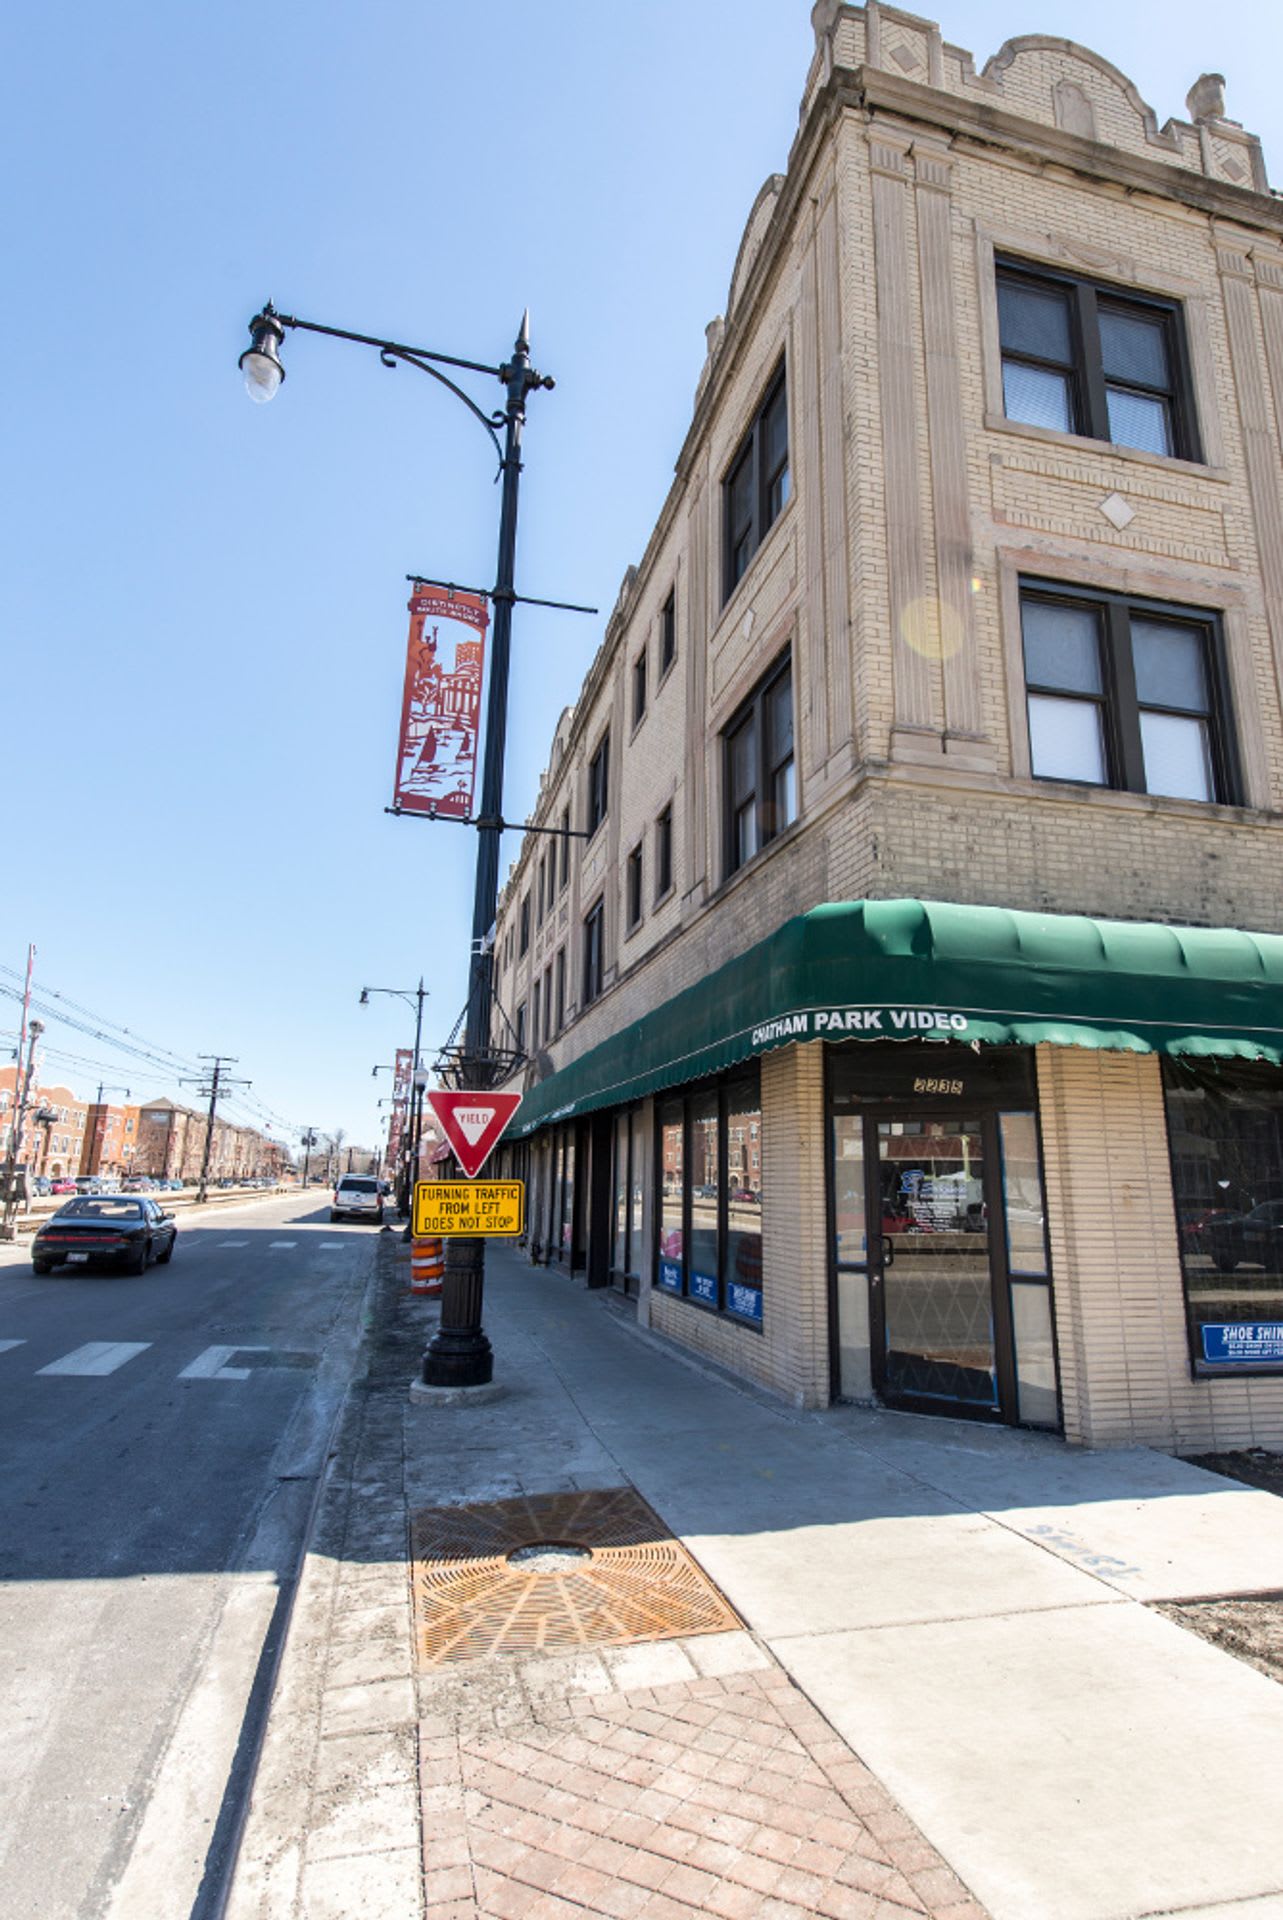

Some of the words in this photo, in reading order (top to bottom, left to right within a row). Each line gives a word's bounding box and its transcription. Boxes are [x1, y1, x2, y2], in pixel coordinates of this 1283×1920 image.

[752, 1014, 808, 1046] CHATHAM
[814, 1010, 883, 1031] PARK
[889, 1010, 968, 1031] VIDEO
[459, 1113, 489, 1125] YIELD
[421, 1188, 469, 1200] TURNING
[475, 1187, 518, 1199] TRAFFIC
[439, 1202, 469, 1215] FROM
[475, 1202, 500, 1214] LEFT
[424, 1217, 455, 1230] DOES
[459, 1217, 481, 1229] NOT
[485, 1216, 514, 1229] STOP
[1222, 1326, 1254, 1341] SHOE
